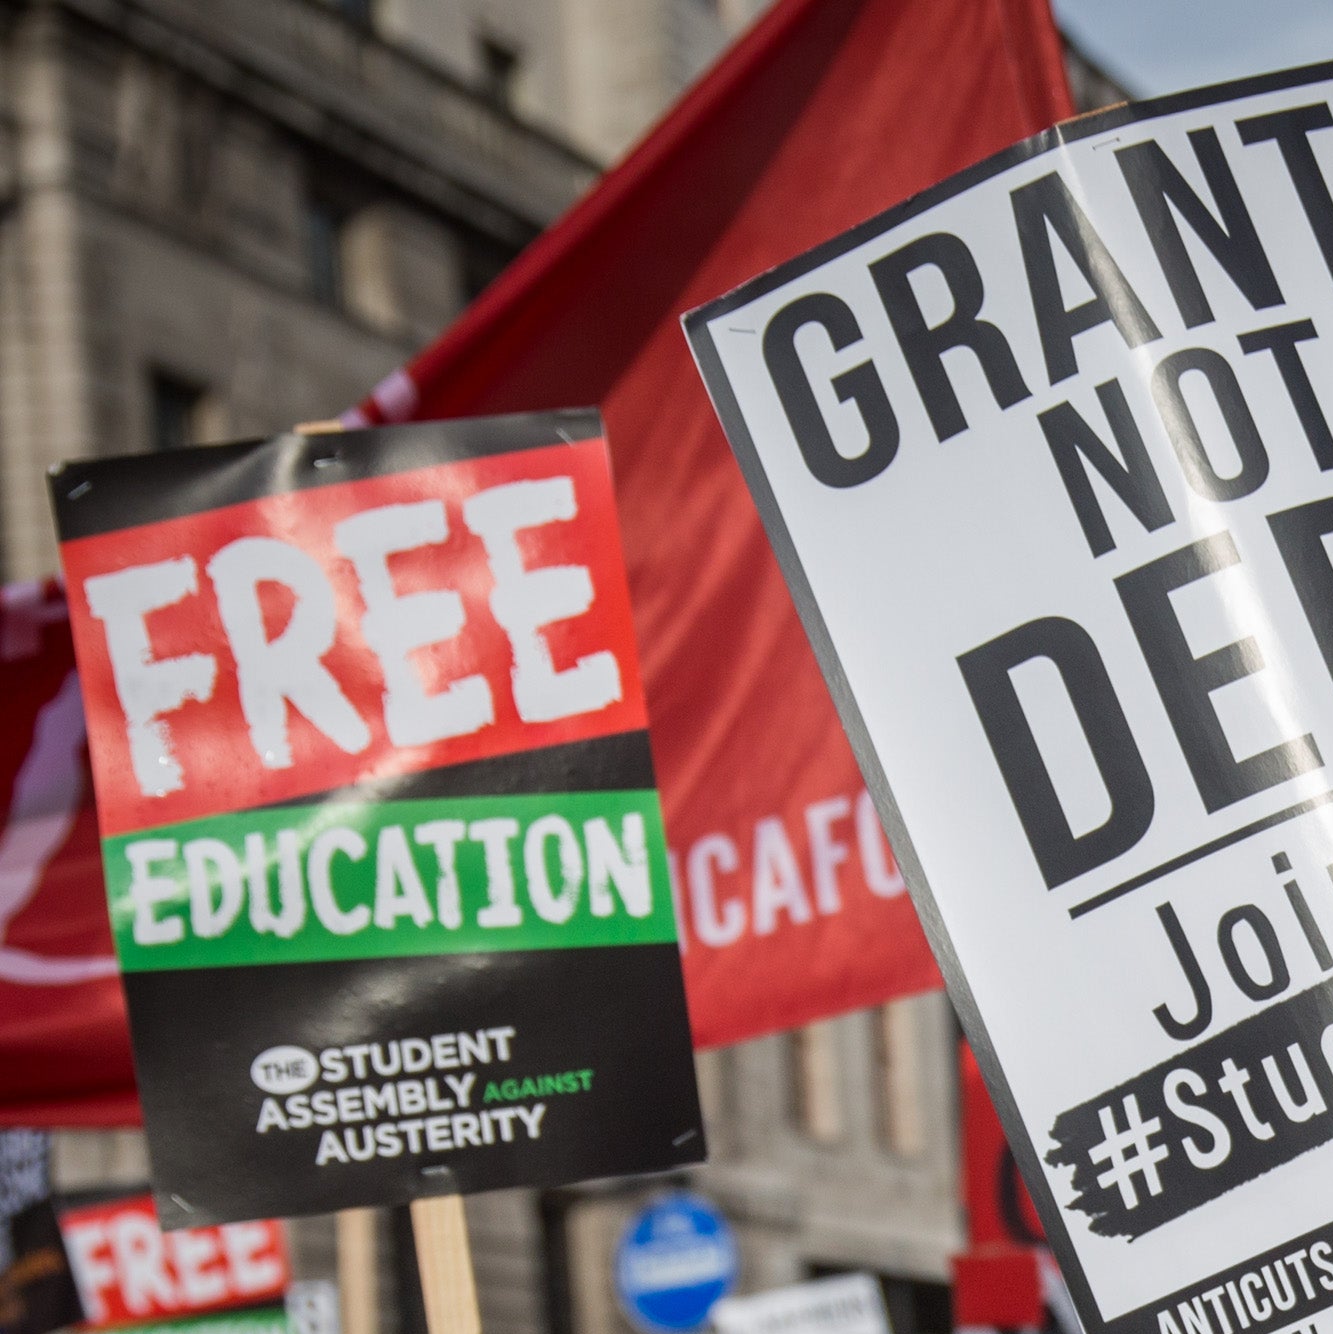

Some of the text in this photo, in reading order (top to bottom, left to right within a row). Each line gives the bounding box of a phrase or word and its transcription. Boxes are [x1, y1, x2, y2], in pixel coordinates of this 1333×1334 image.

[84, 477, 622, 797] FREE
[125, 811, 653, 945] EDUCATION
[262, 1027, 515, 1084] THE STUDENT
[256, 1069, 595, 1133] ASSEMBLY AGAINST
[315, 1105, 546, 1166] AUSTERITY
[62, 1212, 282, 1322] FREE
